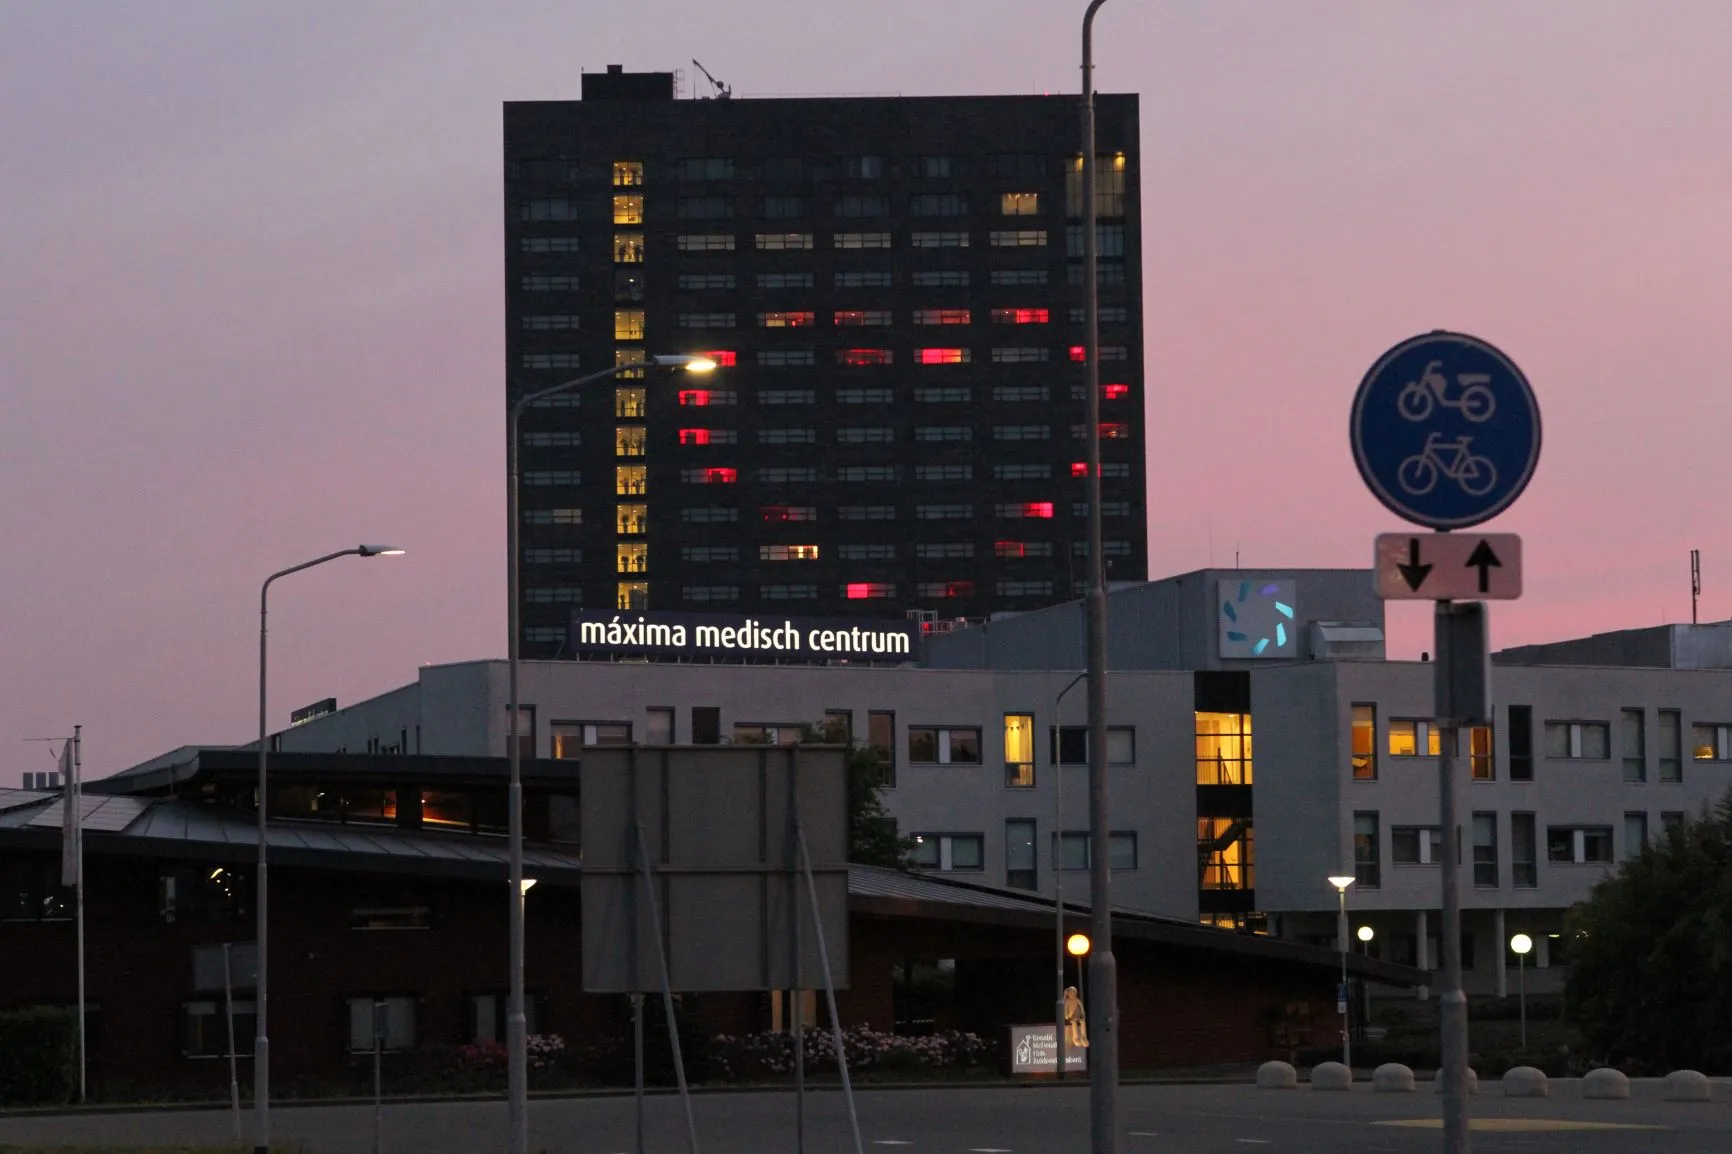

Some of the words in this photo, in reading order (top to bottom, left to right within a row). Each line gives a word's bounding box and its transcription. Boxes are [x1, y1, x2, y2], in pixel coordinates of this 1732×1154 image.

[581, 615, 686, 647] máxima
[695, 619, 800, 651] medisch
[808, 626, 910, 654] centrum
